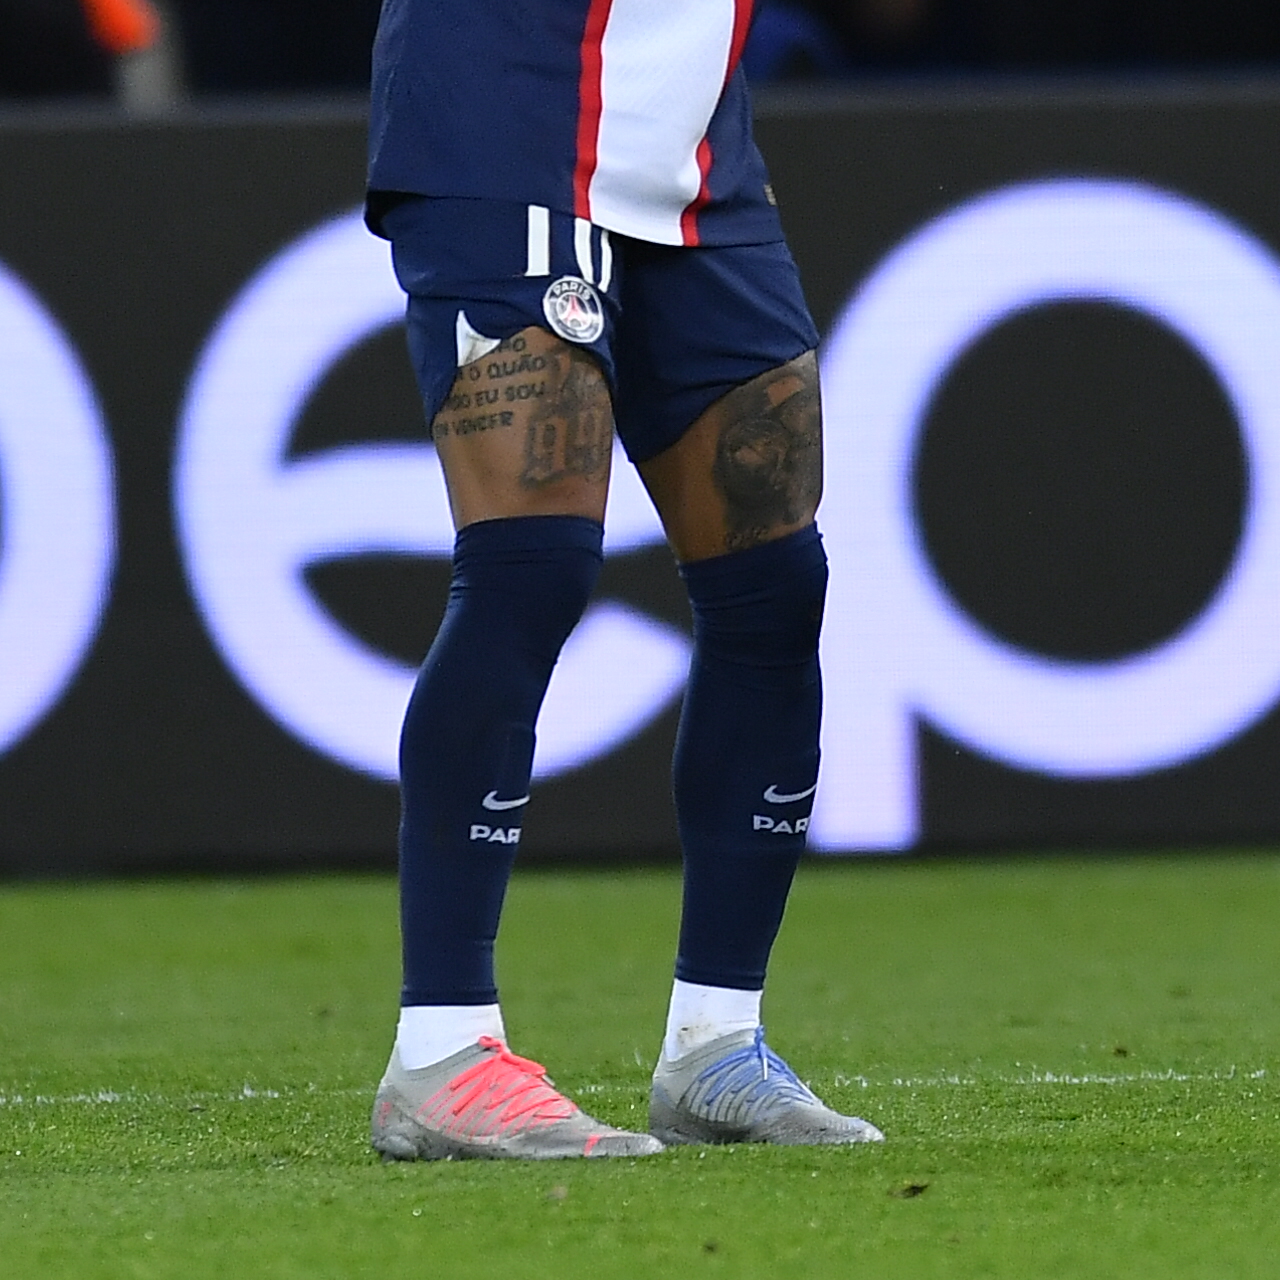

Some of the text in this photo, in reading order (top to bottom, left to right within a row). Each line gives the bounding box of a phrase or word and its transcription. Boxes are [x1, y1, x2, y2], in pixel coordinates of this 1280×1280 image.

[524, 205, 613, 293] 10
[552, 281, 591, 300] PARIS
[469, 824, 521, 844] PAR
